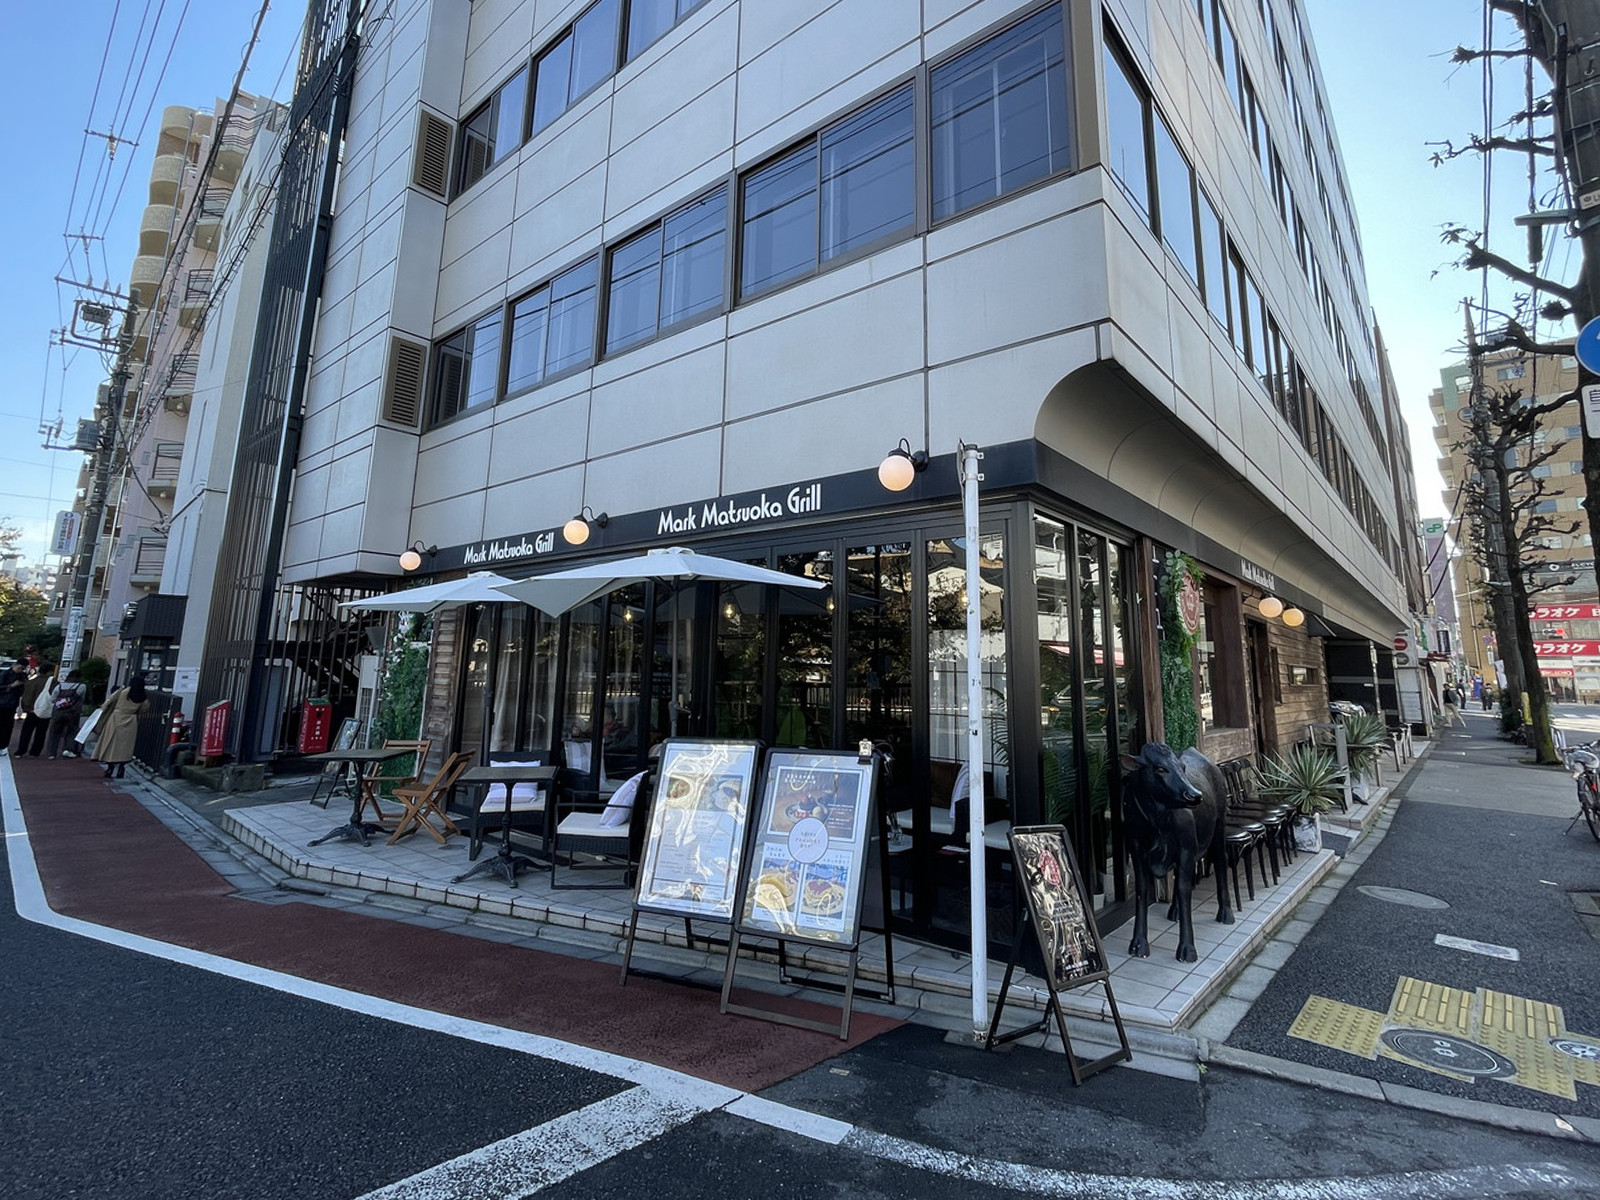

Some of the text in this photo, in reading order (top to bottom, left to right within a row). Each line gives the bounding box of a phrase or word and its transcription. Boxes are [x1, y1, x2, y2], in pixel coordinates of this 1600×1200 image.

[657, 483, 822, 535] Mark Matsuoka Grill
[464, 532, 555, 565] Mark Matsuoka Grill
